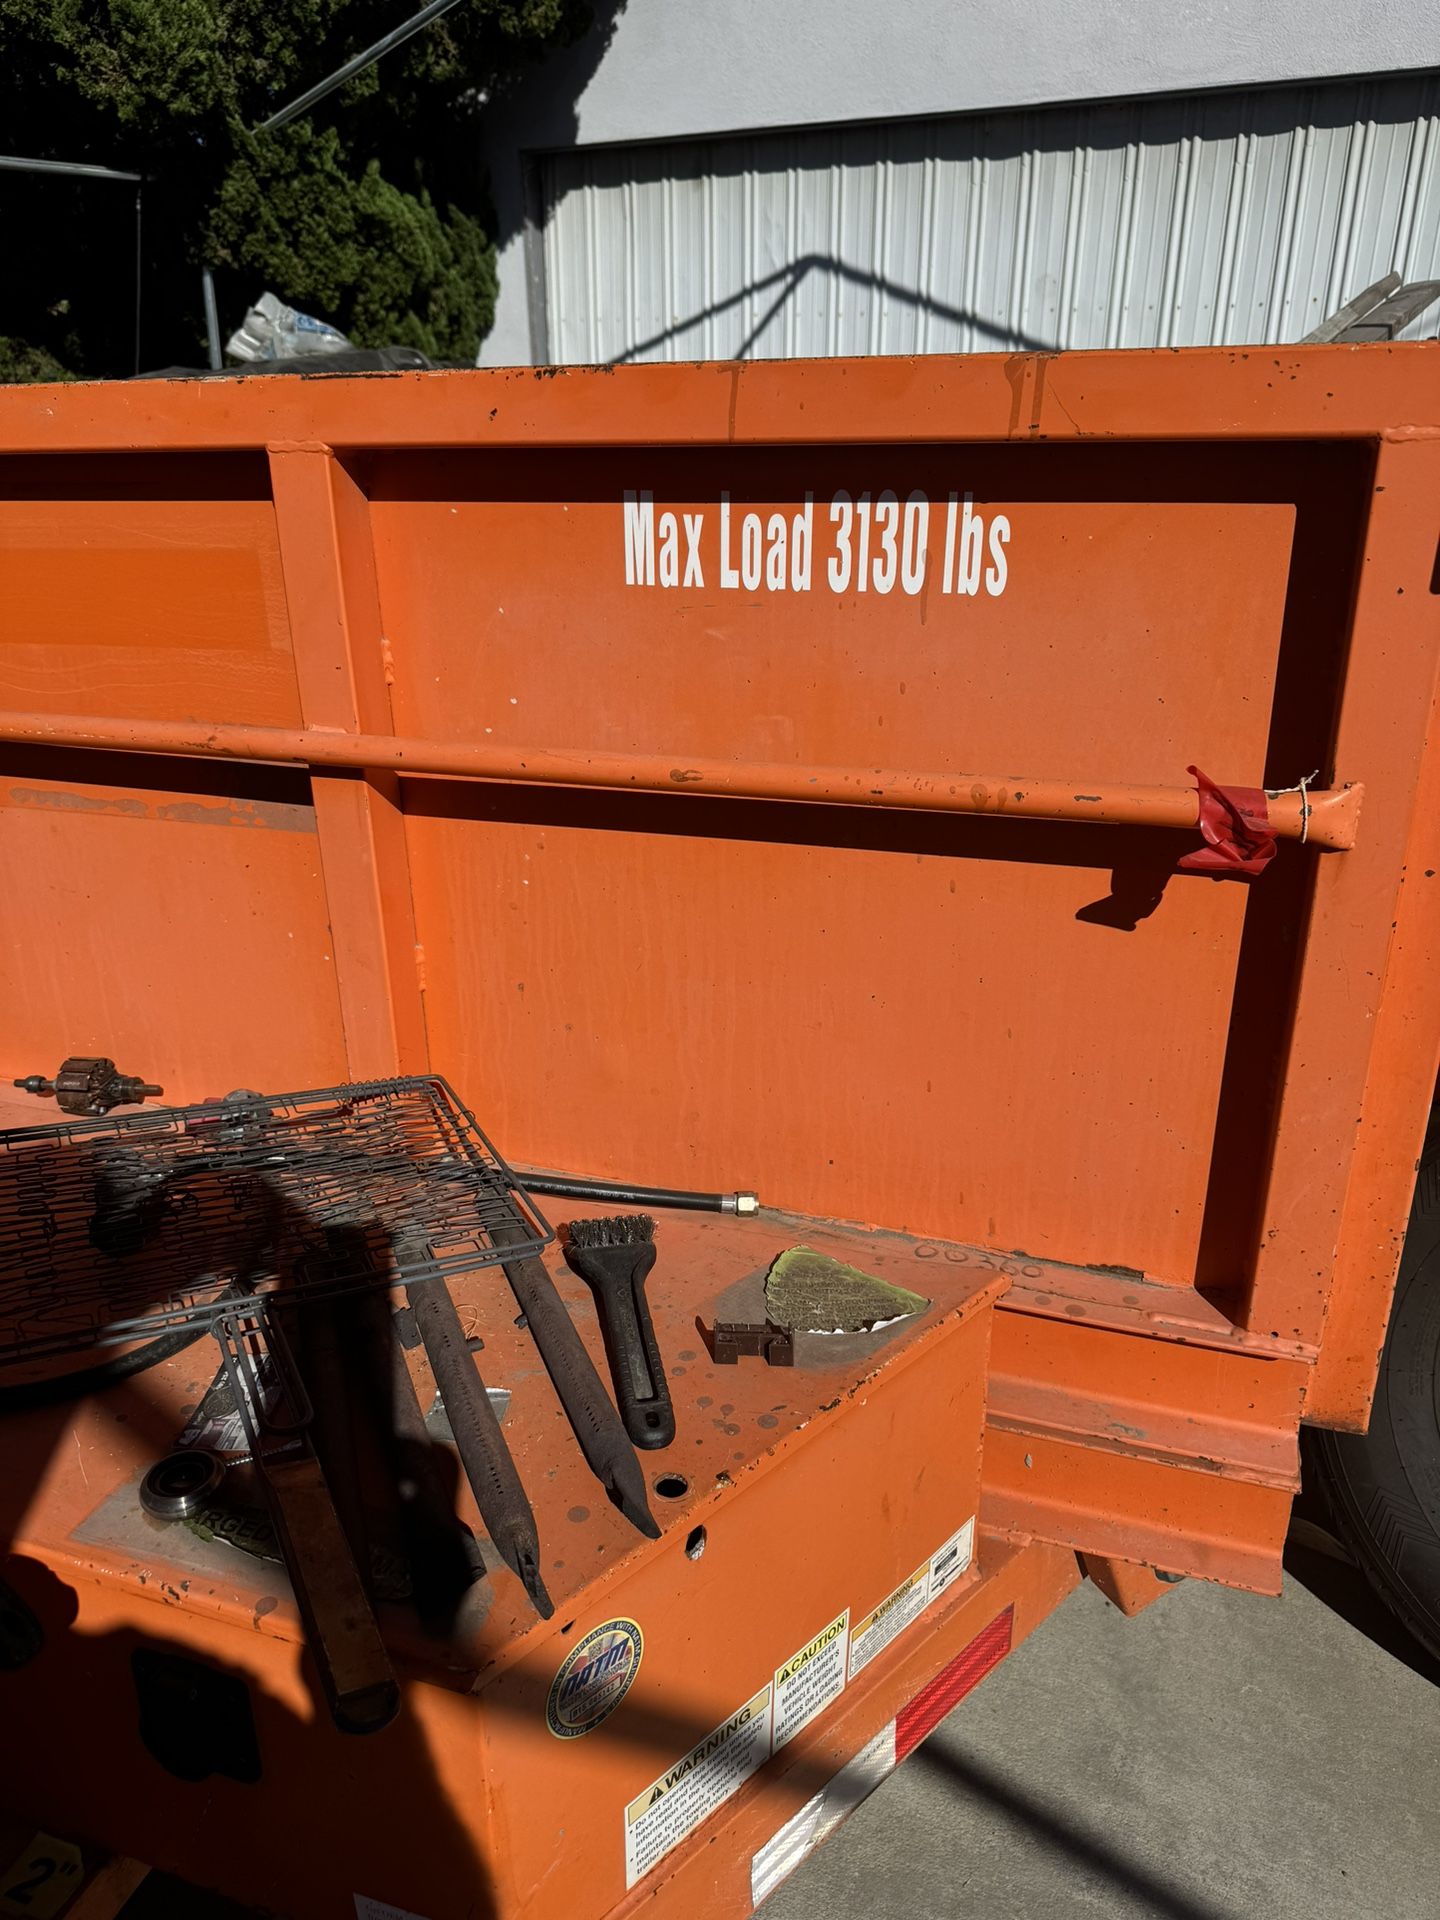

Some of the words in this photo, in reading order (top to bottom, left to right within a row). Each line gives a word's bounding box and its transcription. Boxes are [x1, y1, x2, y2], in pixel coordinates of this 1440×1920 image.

[623, 490, 705, 588] Max
[720, 490, 814, 592] Load
[828, 489, 930, 595] 3130
[942, 490, 1011, 597] lbs
[879, 1578, 914, 1614] WARNING
[559, 1622, 615, 1674] COMPLIANCE
[614, 1622, 634, 1633] WITH
[630, 1628, 639, 1655] NATM
[781, 1647, 839, 1706] MANUFACTURER'S
[791, 1617, 844, 1673] CAUTION
[812, 1639, 836, 1667] EXCEED
[775, 1703, 803, 1734] RATINGS
[815, 1666, 842, 1697] LOADING
[784, 1685, 810, 1715] VEHICLE
[812, 1661, 836, 1689] WEIGHT
[636, 1818, 652, 1839] have
[655, 1802, 671, 1821] read
[689, 1751, 728, 1791] understand
[743, 1720, 762, 1744] safety
[662, 1778, 690, 1809] operate
[692, 1763, 704, 1780] this
[707, 1744, 727, 1767] trailer
[729, 1724, 750, 1747] unless
[664, 1705, 750, 1792] WARNING
[636, 1804, 678, 1847] information
[701, 1759, 728, 1789] owner's
[636, 1829, 661, 1858] Failure
[674, 1791, 704, 1825] properly
[707, 1765, 734, 1795] operate
[637, 1831, 669, 1866] maintain
[686, 1794, 710, 1822] towing
[712, 1769, 736, 1797] vehicle
[637, 1849, 659, 1874] trailer
[677, 1813, 698, 1837] result
